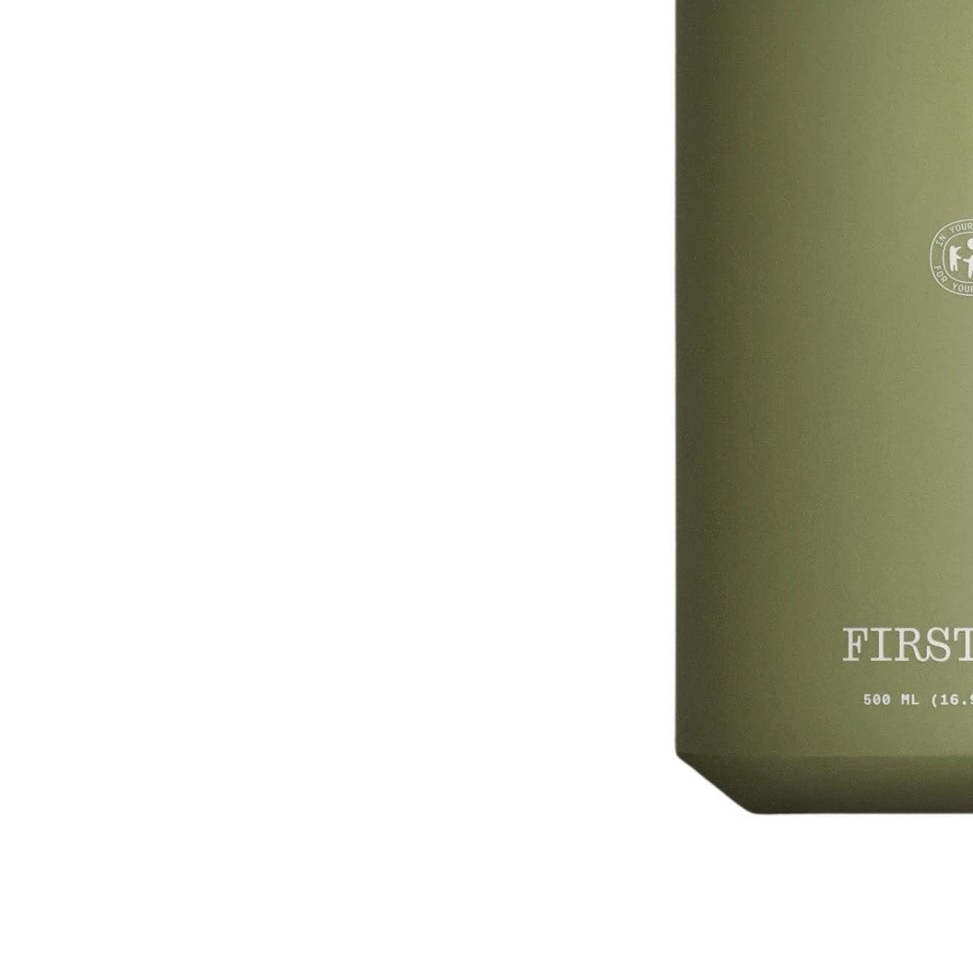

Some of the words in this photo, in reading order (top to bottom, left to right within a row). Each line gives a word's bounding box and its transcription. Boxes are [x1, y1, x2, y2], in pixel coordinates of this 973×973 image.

[935, 234, 947, 247] IN
[948, 222, 973, 234] YOUR
[933, 265, 949, 284] FOR
[863, 693, 891, 706] 500
[901, 693, 920, 706] ML
